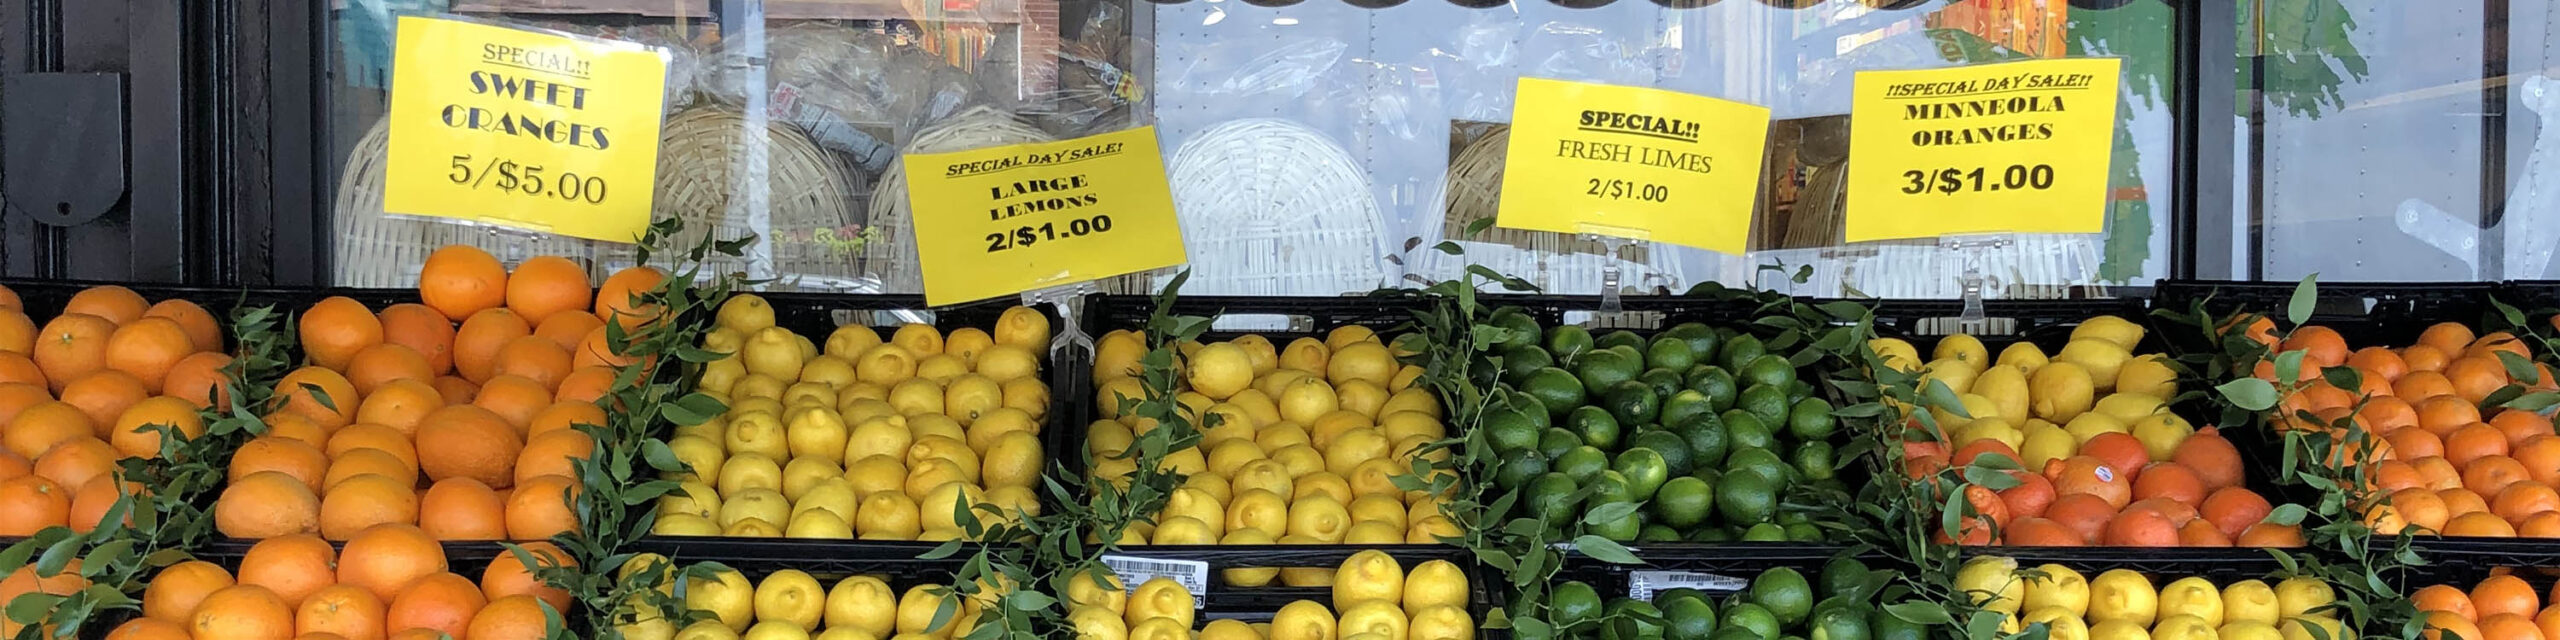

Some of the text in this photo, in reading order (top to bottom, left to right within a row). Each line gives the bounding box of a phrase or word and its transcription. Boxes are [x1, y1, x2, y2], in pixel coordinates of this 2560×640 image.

[482, 43, 591, 75] SPECIAL!!
[469, 70, 592, 110] SWEET
[1886, 73, 2093, 96] !!SPECIAL DAY SALE!!
[1903, 96, 2065, 120] MINNEOLA
[442, 104, 610, 150] ORANGES
[1580, 110, 1700, 138] SPECIAL!!
[1911, 123, 2053, 146] ORANGES
[946, 143, 1123, 176] SPECIAL DAY SALE!
[1556, 139, 1713, 174] FRESH LIMES
[449, 153, 607, 204] 5/$5.00
[991, 174, 1088, 200] LARGE
[1587, 178, 1668, 203] 2/$1.00
[1901, 164, 2054, 195] 3/$1.00
[990, 193, 1098, 221] LEMONS
[985, 215, 1112, 253] 2/$1.00
